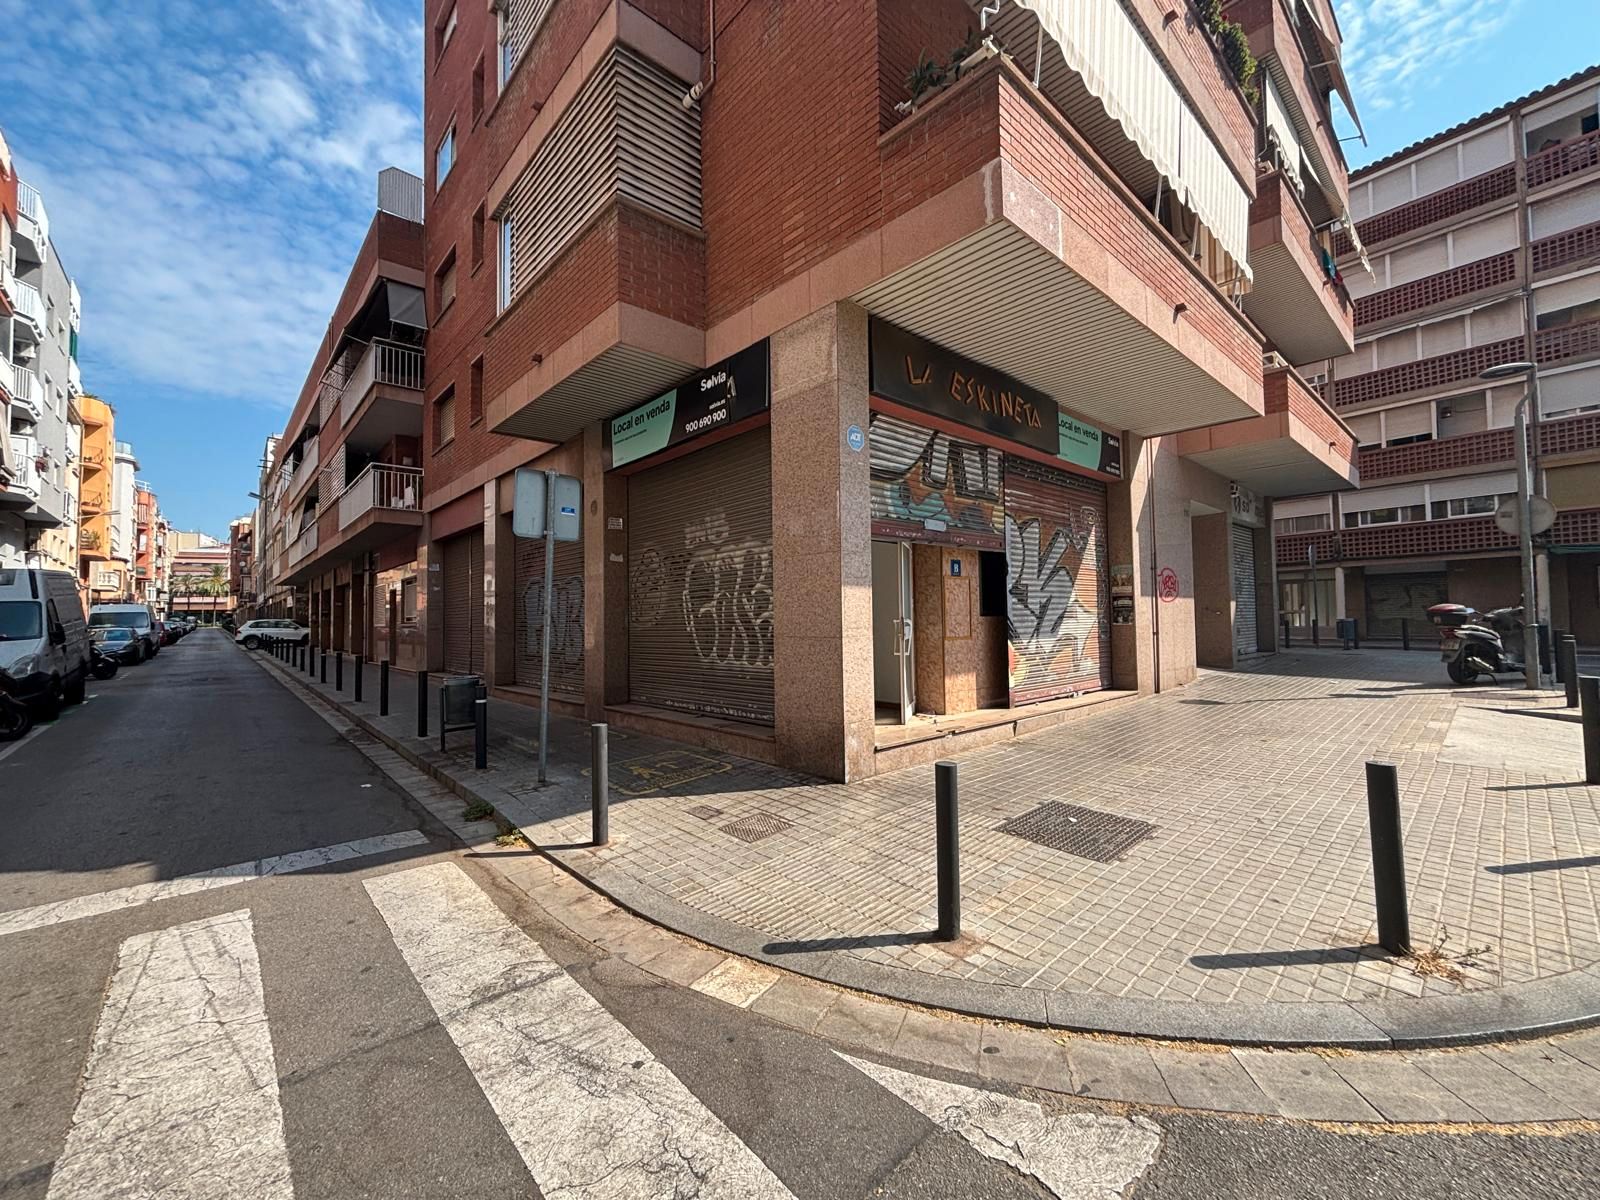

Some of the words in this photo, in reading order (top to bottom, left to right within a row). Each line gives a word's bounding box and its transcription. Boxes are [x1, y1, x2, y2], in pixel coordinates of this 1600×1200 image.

[700, 371, 727, 392] Solvia
[951, 370, 1042, 429] ESKINETA
[613, 415, 633, 436] Local
[634, 413, 645, 427] en
[646, 400, 670, 421] venda
[685, 420, 699, 433] 900
[699, 414, 712, 429] 690
[712, 408, 727, 423] 900
[1074, 424, 1082, 435] en
[1082, 428, 1099, 442] venda
